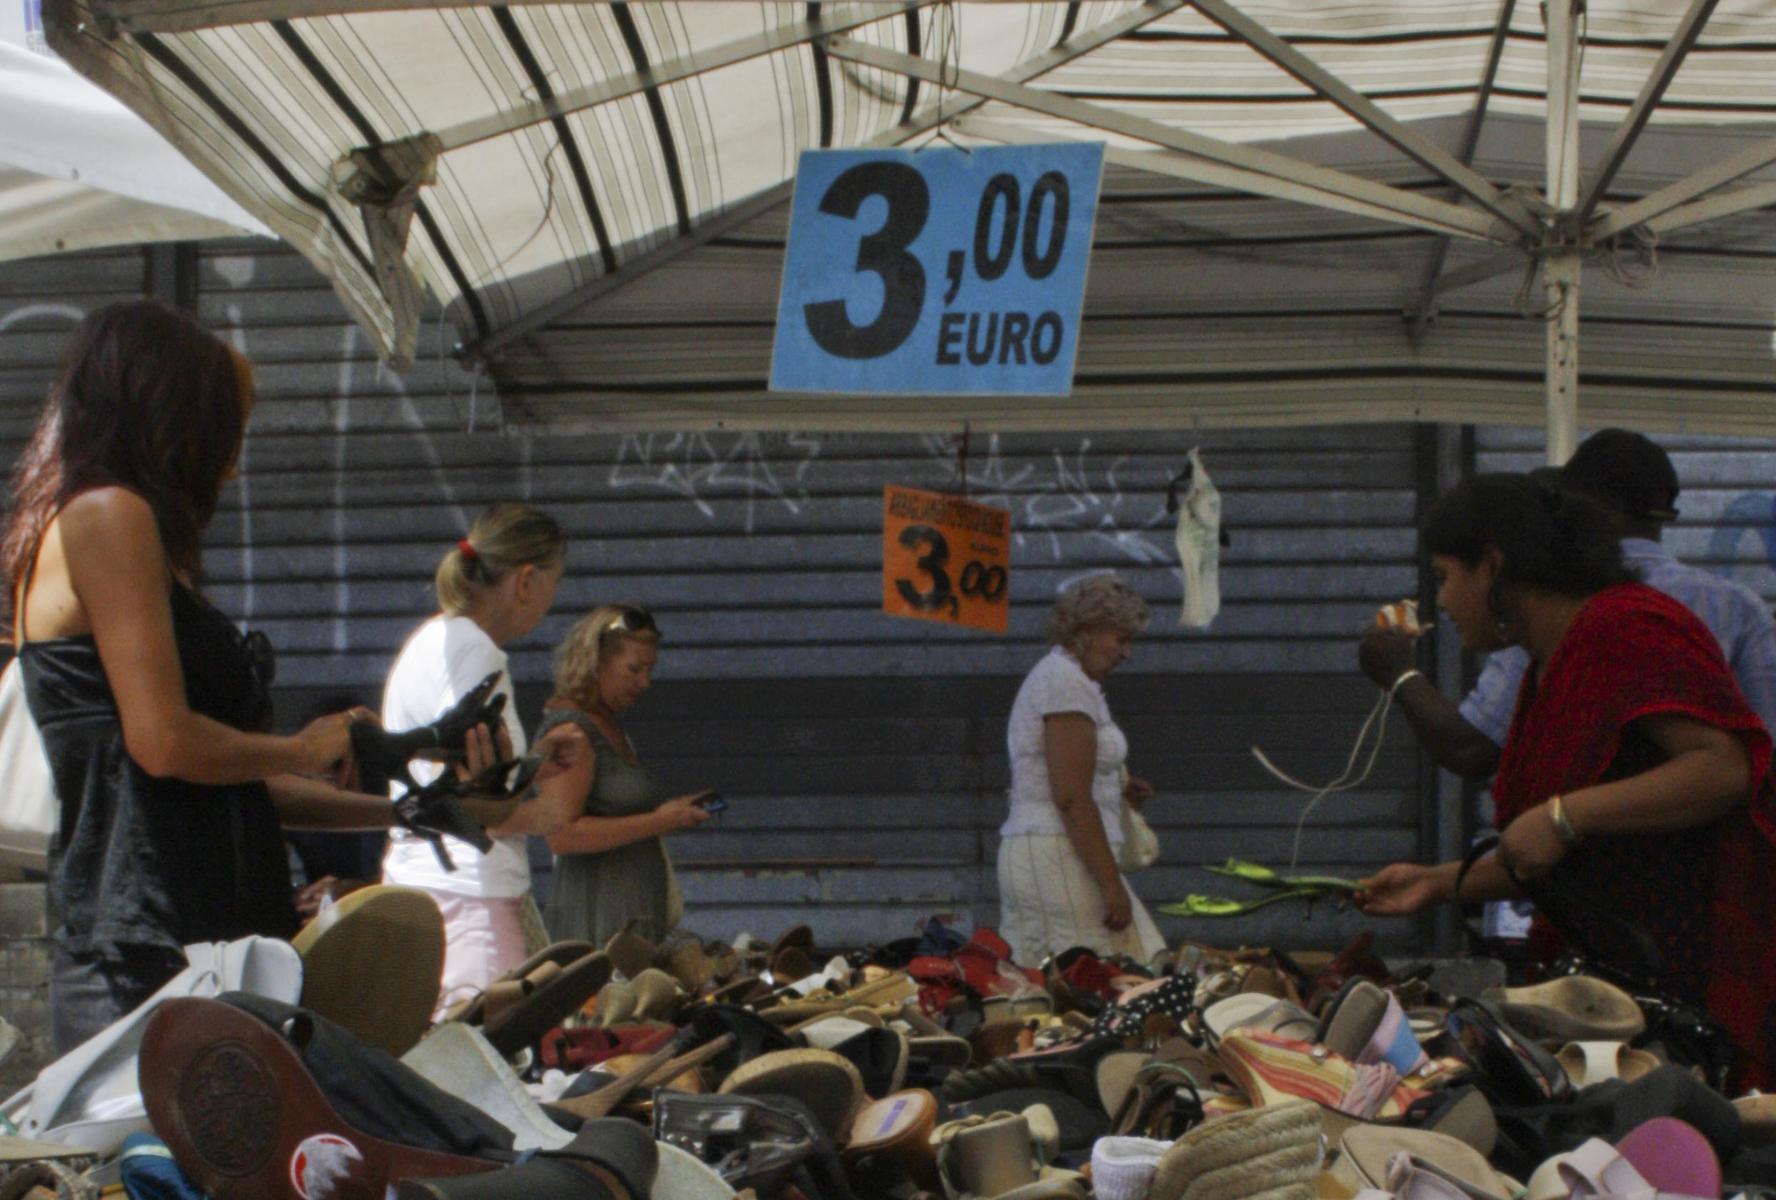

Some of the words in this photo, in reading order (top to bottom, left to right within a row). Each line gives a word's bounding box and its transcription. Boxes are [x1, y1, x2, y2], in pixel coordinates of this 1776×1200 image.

[803, 160, 1071, 361] 3,00
[935, 310, 1064, 367] EURO
[895, 523, 1007, 621] 3,00
